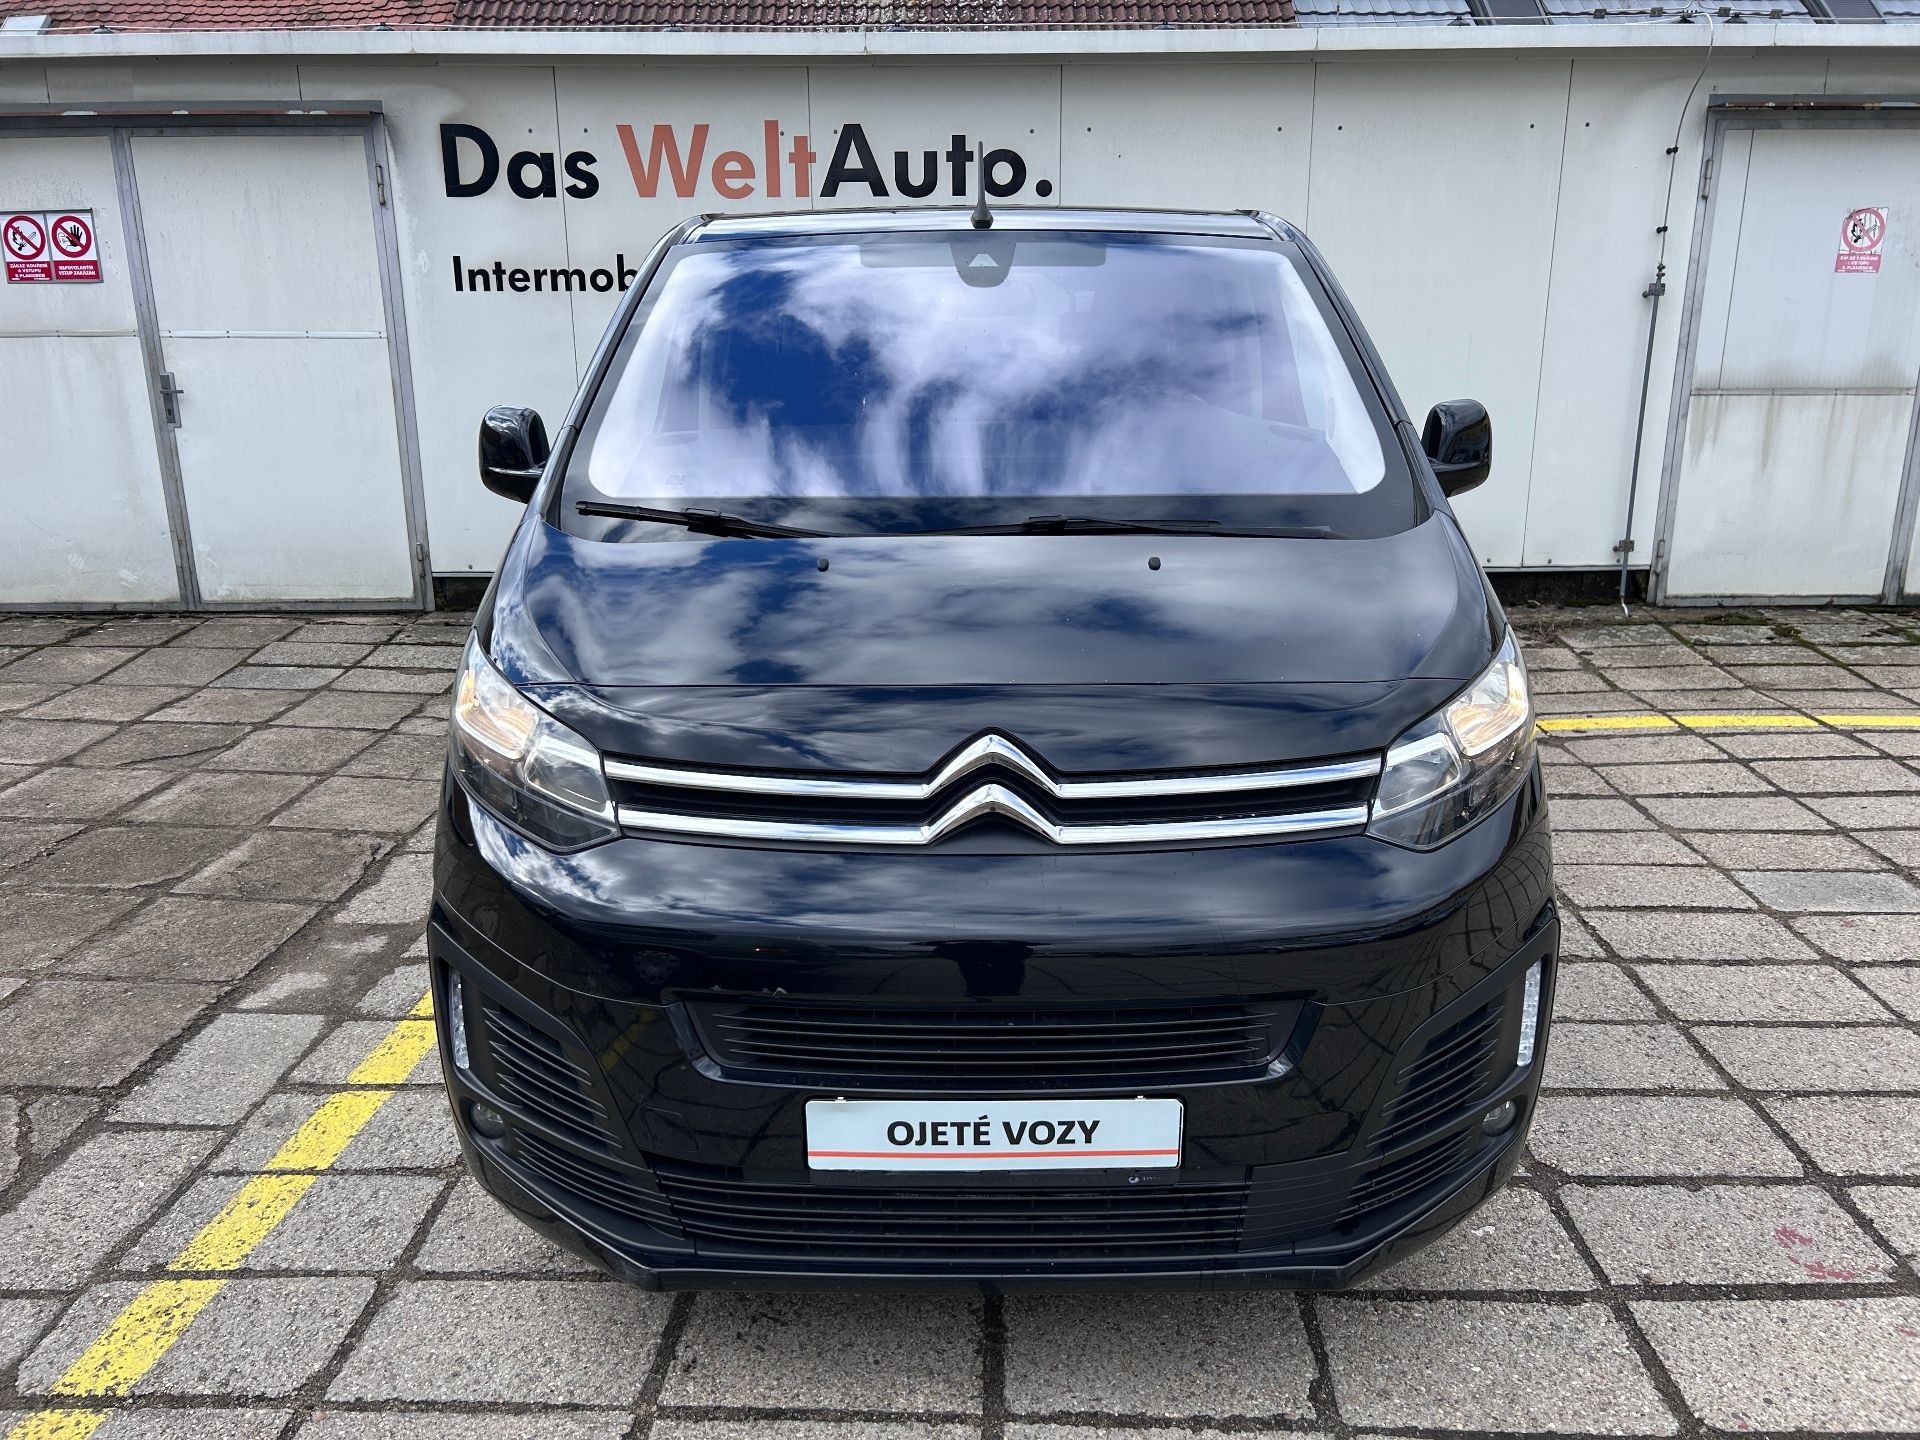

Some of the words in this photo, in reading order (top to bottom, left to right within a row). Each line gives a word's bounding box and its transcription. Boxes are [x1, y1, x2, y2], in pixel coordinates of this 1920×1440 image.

[439, 123, 600, 199] Das
[616, 119, 1053, 199] WeltAuto.
[887, 1115, 990, 1146] OJETÉ
[1002, 1120, 1100, 1145] VOZY
